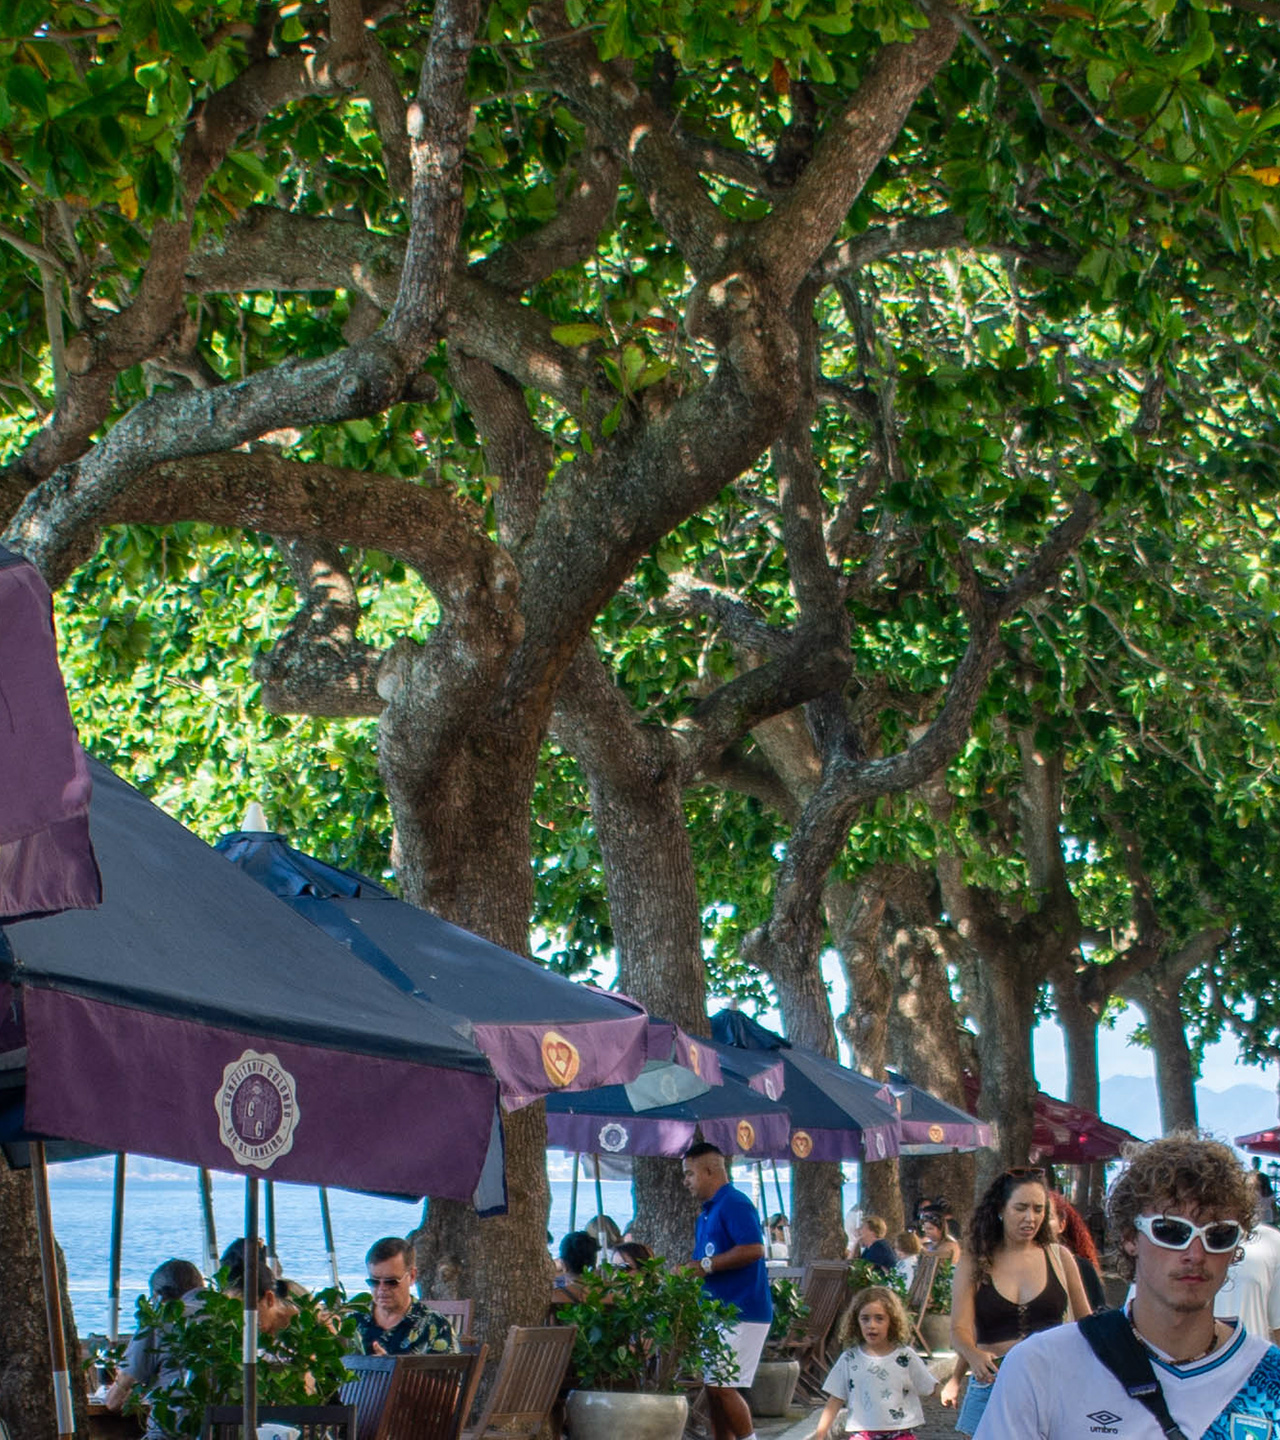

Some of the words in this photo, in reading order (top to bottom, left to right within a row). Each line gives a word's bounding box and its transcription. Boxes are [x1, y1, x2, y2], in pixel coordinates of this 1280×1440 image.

[224, 1061, 265, 1108] CONFEITARIA
[266, 1067, 293, 1118] COLOMBO
[250, 1134, 283, 1158] JANEIRO
[1089, 1425, 1119, 1435] umbro
